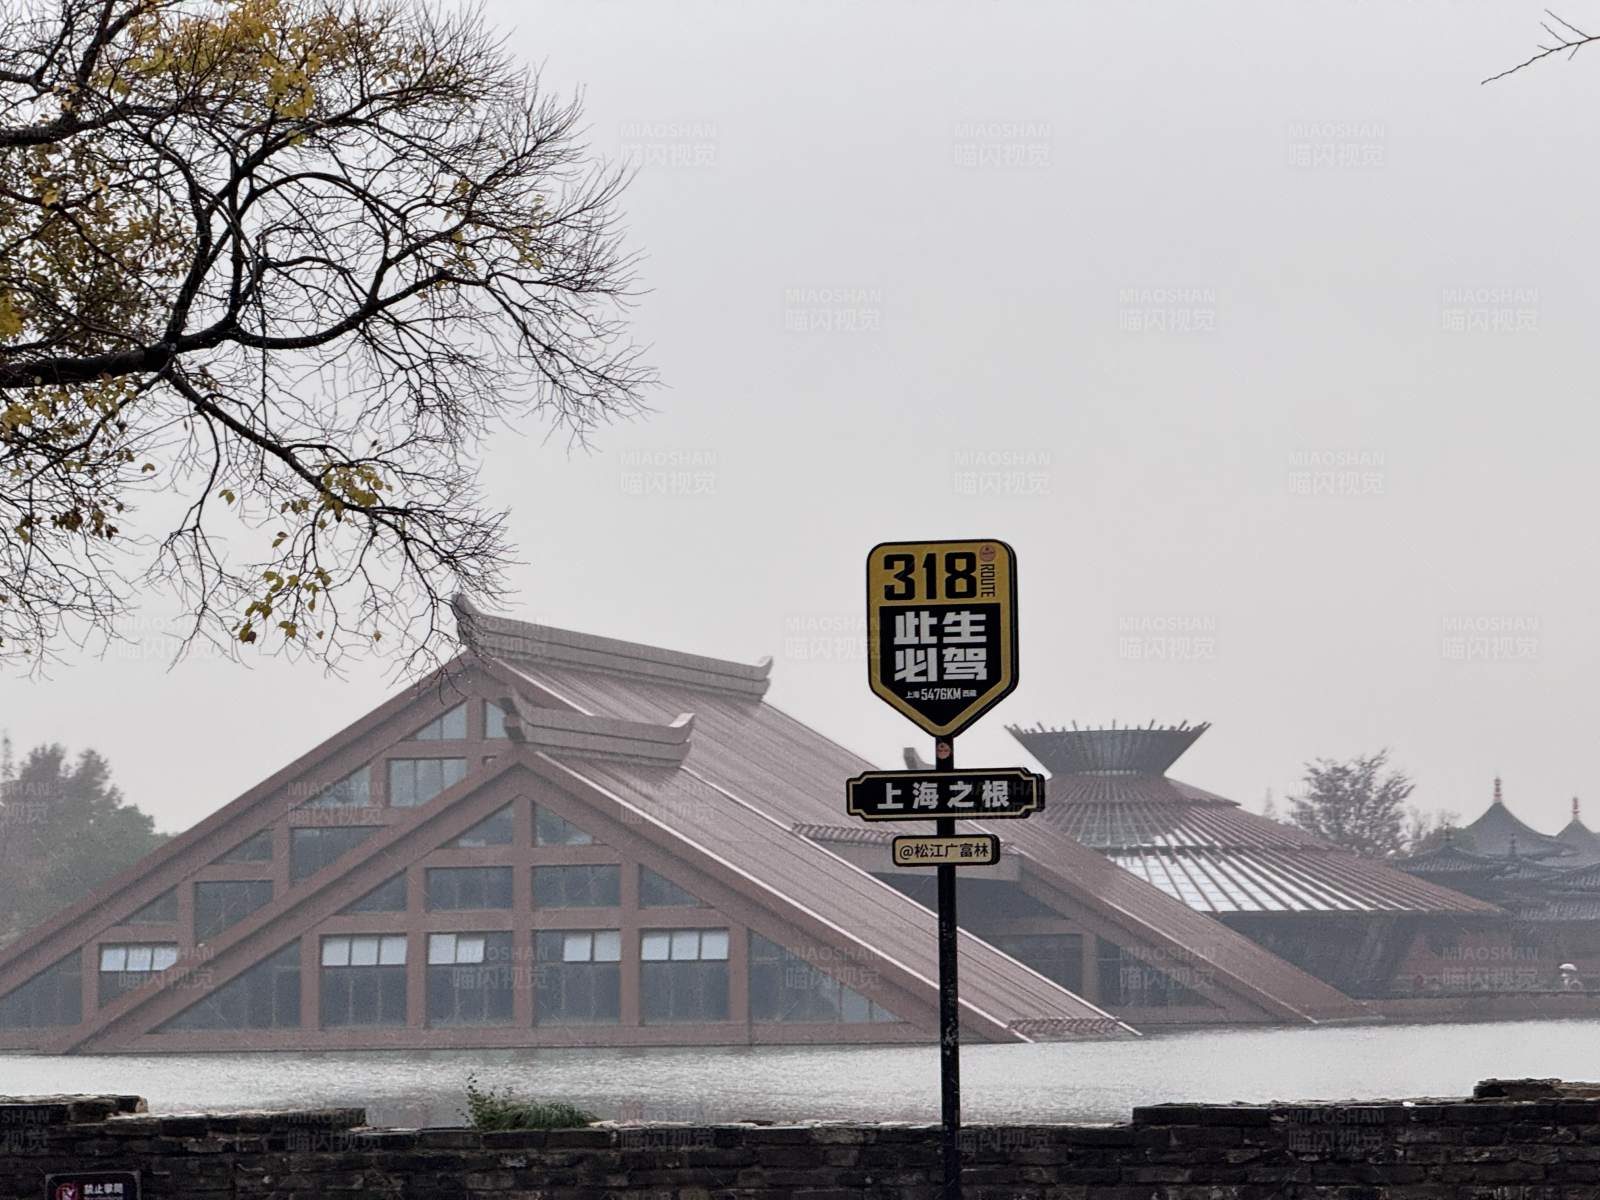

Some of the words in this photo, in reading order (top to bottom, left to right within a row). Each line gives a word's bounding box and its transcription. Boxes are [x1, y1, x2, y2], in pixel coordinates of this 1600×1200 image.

[884, 552, 977, 600] 318
[980, 563, 995, 597] ROUTE
[894, 611, 987, 645] 此生
[894, 647, 987, 682] 必驾
[921, 687, 962, 701] 5476KM
[877, 779, 1010, 809] 上海之根
[899, 842, 990, 860] @松江广富林
